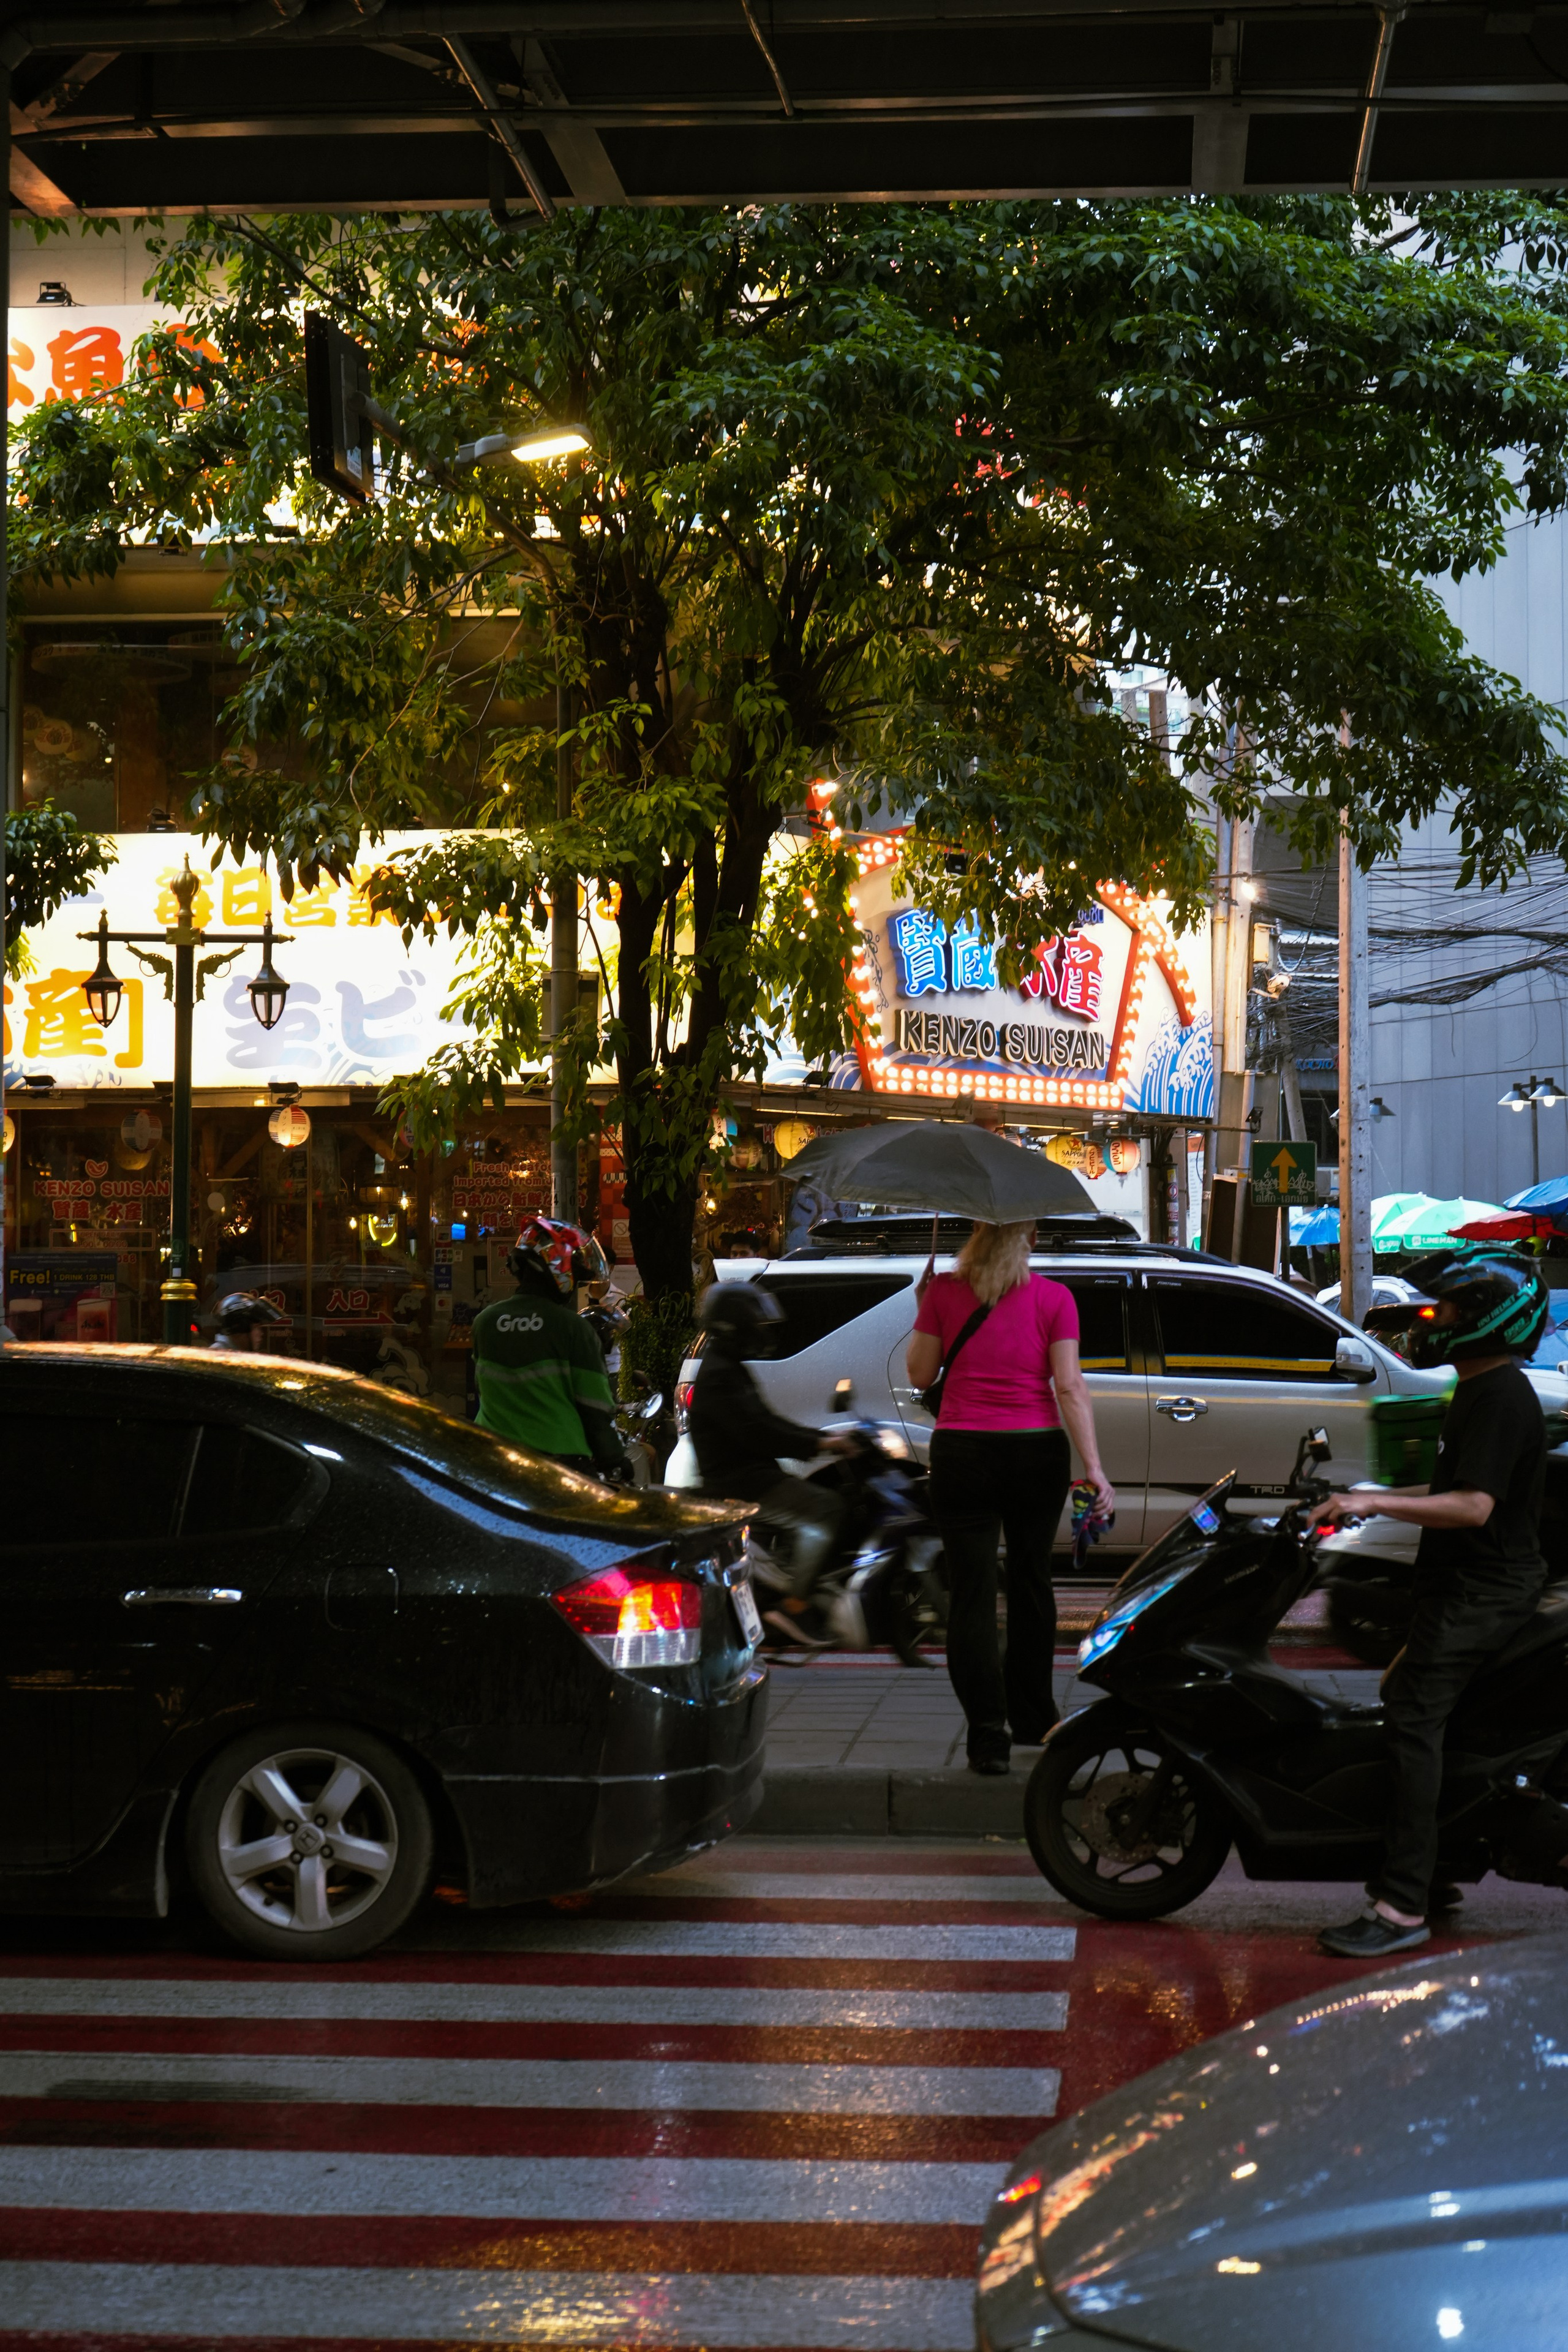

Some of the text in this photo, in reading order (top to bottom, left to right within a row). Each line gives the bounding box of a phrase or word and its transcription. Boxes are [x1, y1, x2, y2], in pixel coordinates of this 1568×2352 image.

[898, 1009, 1106, 1070] KENZO SUISAN
[1111, 1142, 1123, 1166] Orion
[473, 1161, 510, 1173] Fresh
[34, 1180, 170, 1197] KENZO SUISAN
[453, 1175, 510, 1188] imported
[513, 1175, 545, 1187] from
[53, 1199, 143, 1221] 賢蔵 水産
[9, 1268, 51, 1285] Free!
[326, 1288, 370, 1312] 入口
[496, 1313, 545, 1332] Grab
[1250, 1485, 1285, 1494] TRD
